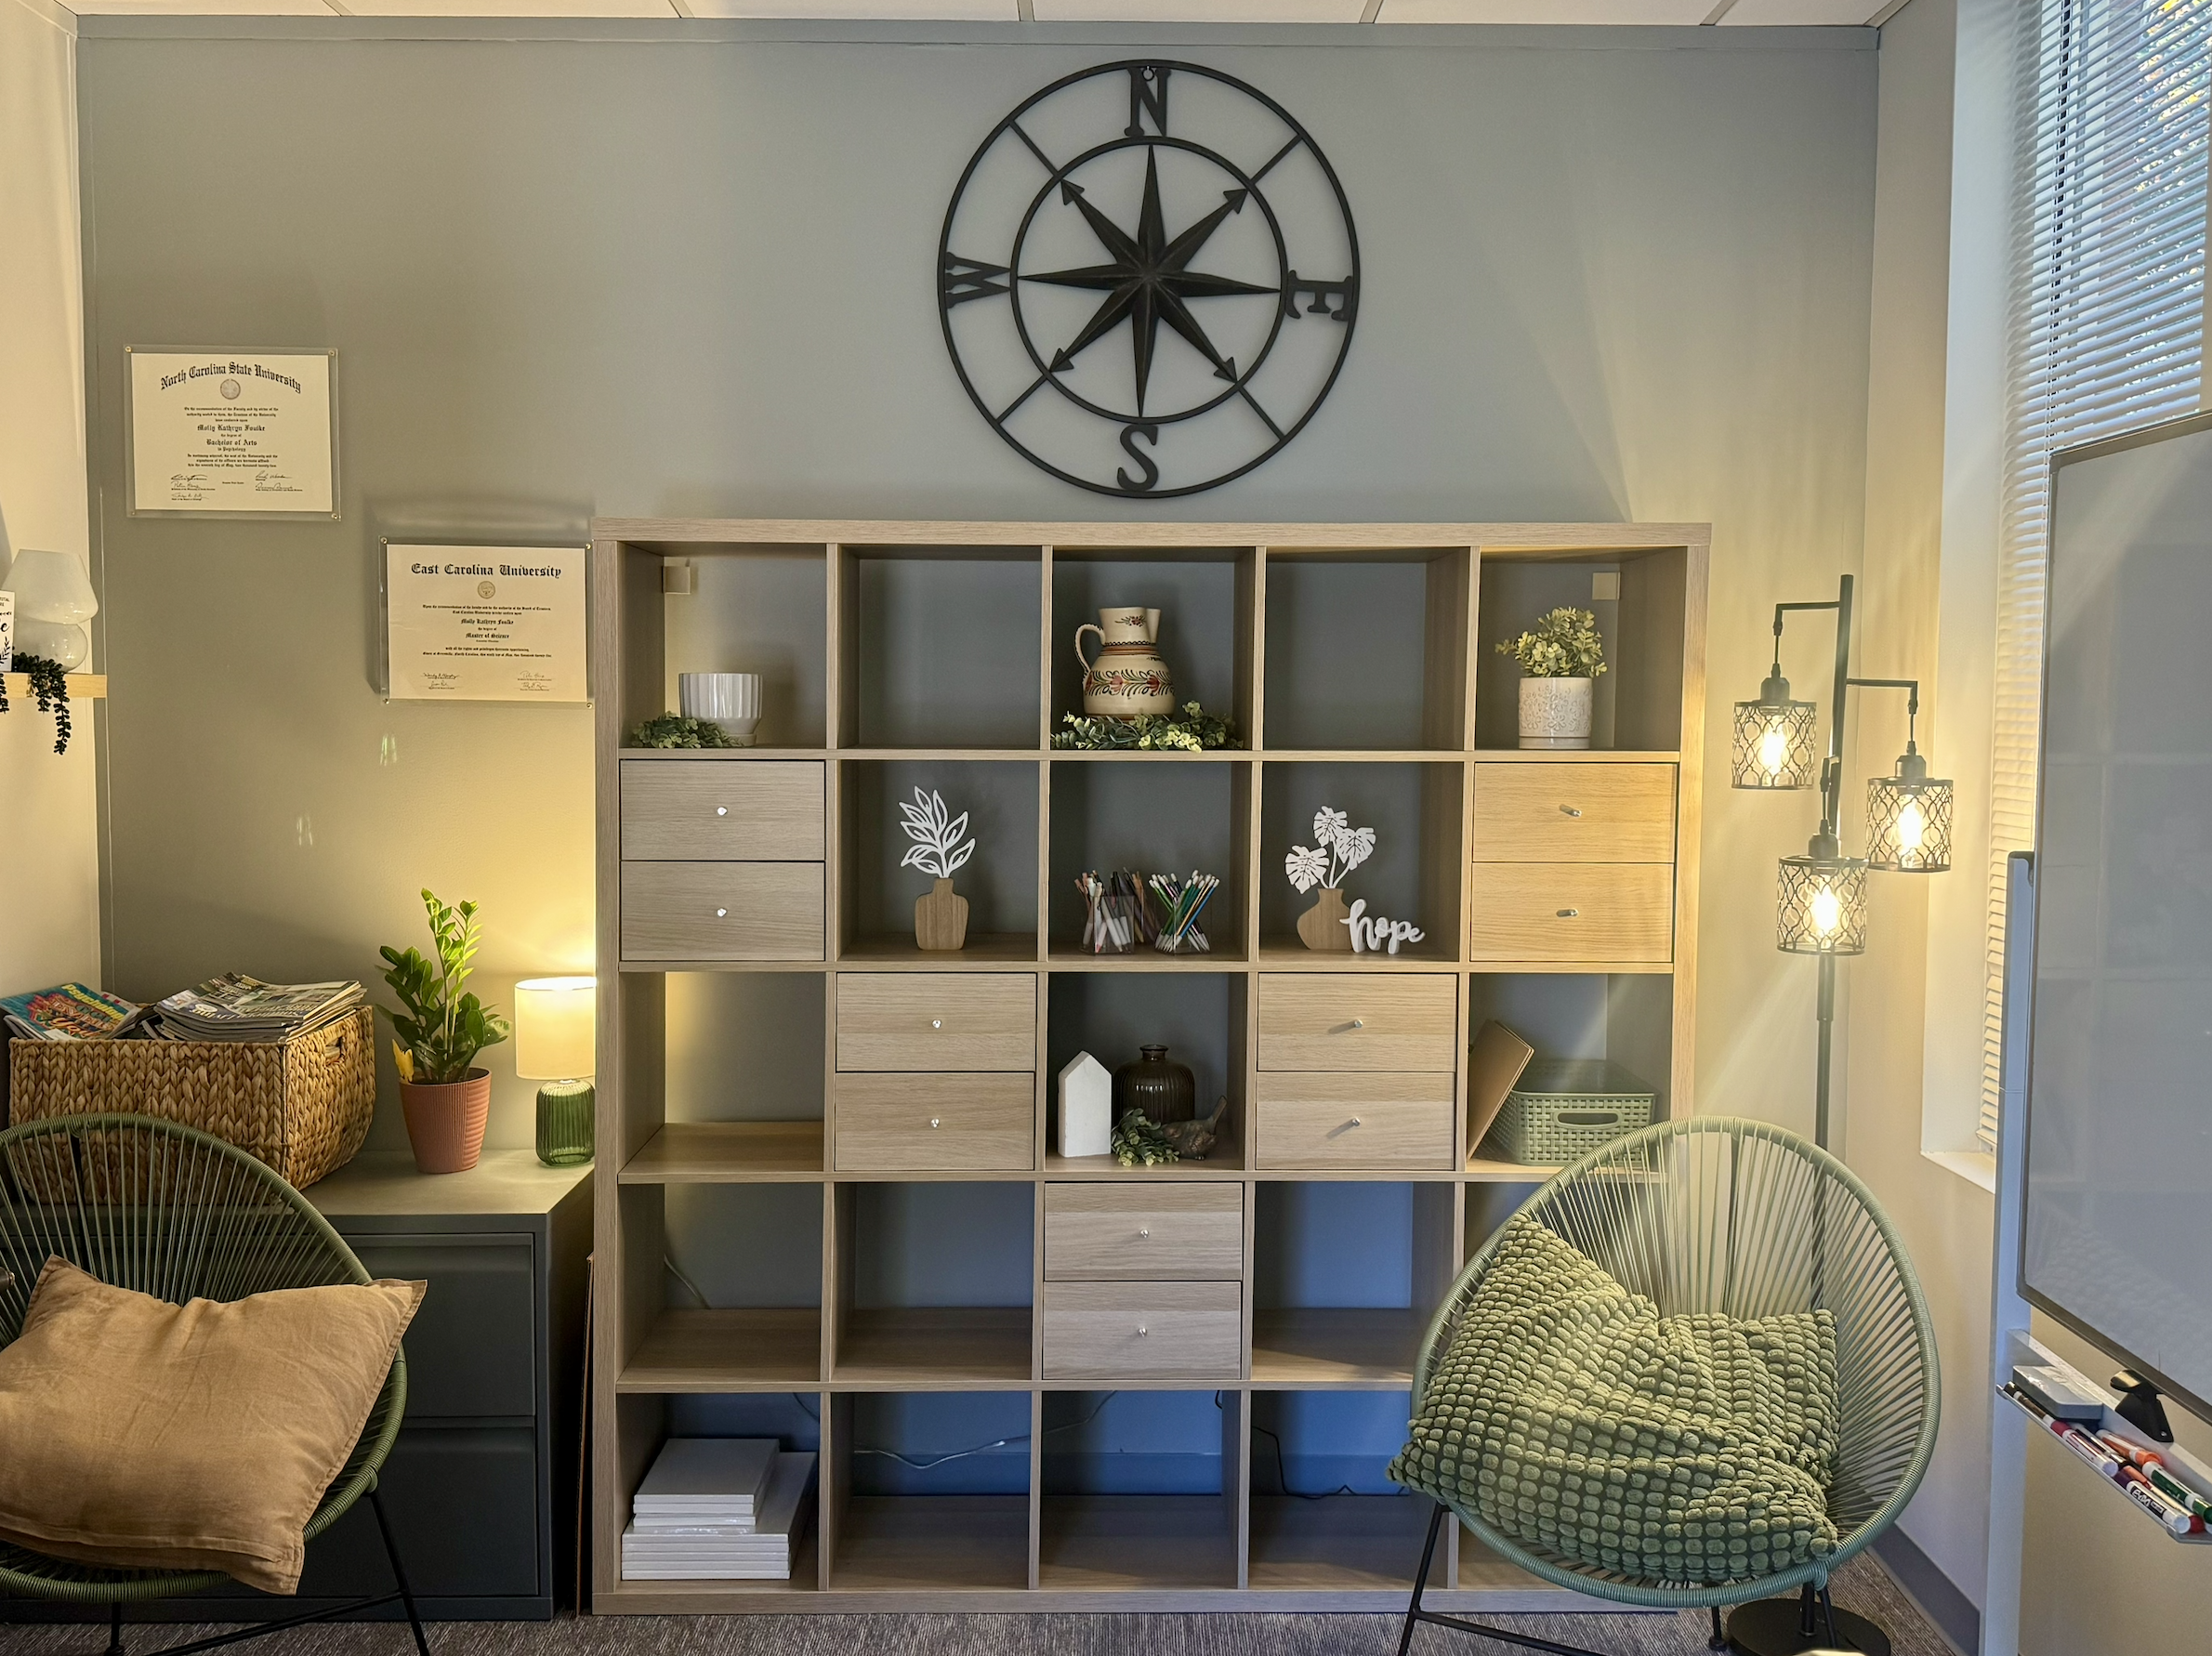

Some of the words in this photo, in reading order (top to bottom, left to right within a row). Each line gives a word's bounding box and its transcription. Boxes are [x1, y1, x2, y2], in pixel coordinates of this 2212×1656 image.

[1124, 67, 1171, 137] N
[944, 252, 1011, 309] W
[1285, 269, 1352, 321] E
[160, 369, 187, 390] North
[189, 362, 227, 379] Carolina
[229, 361, 252, 376] State
[254, 363, 301, 394] University
[1117, 424, 1159, 491] S
[411, 562, 440, 574] East
[443, 563, 494, 576] Carolina
[499, 564, 561, 579] University
[1339, 898, 1426, 954] hope
